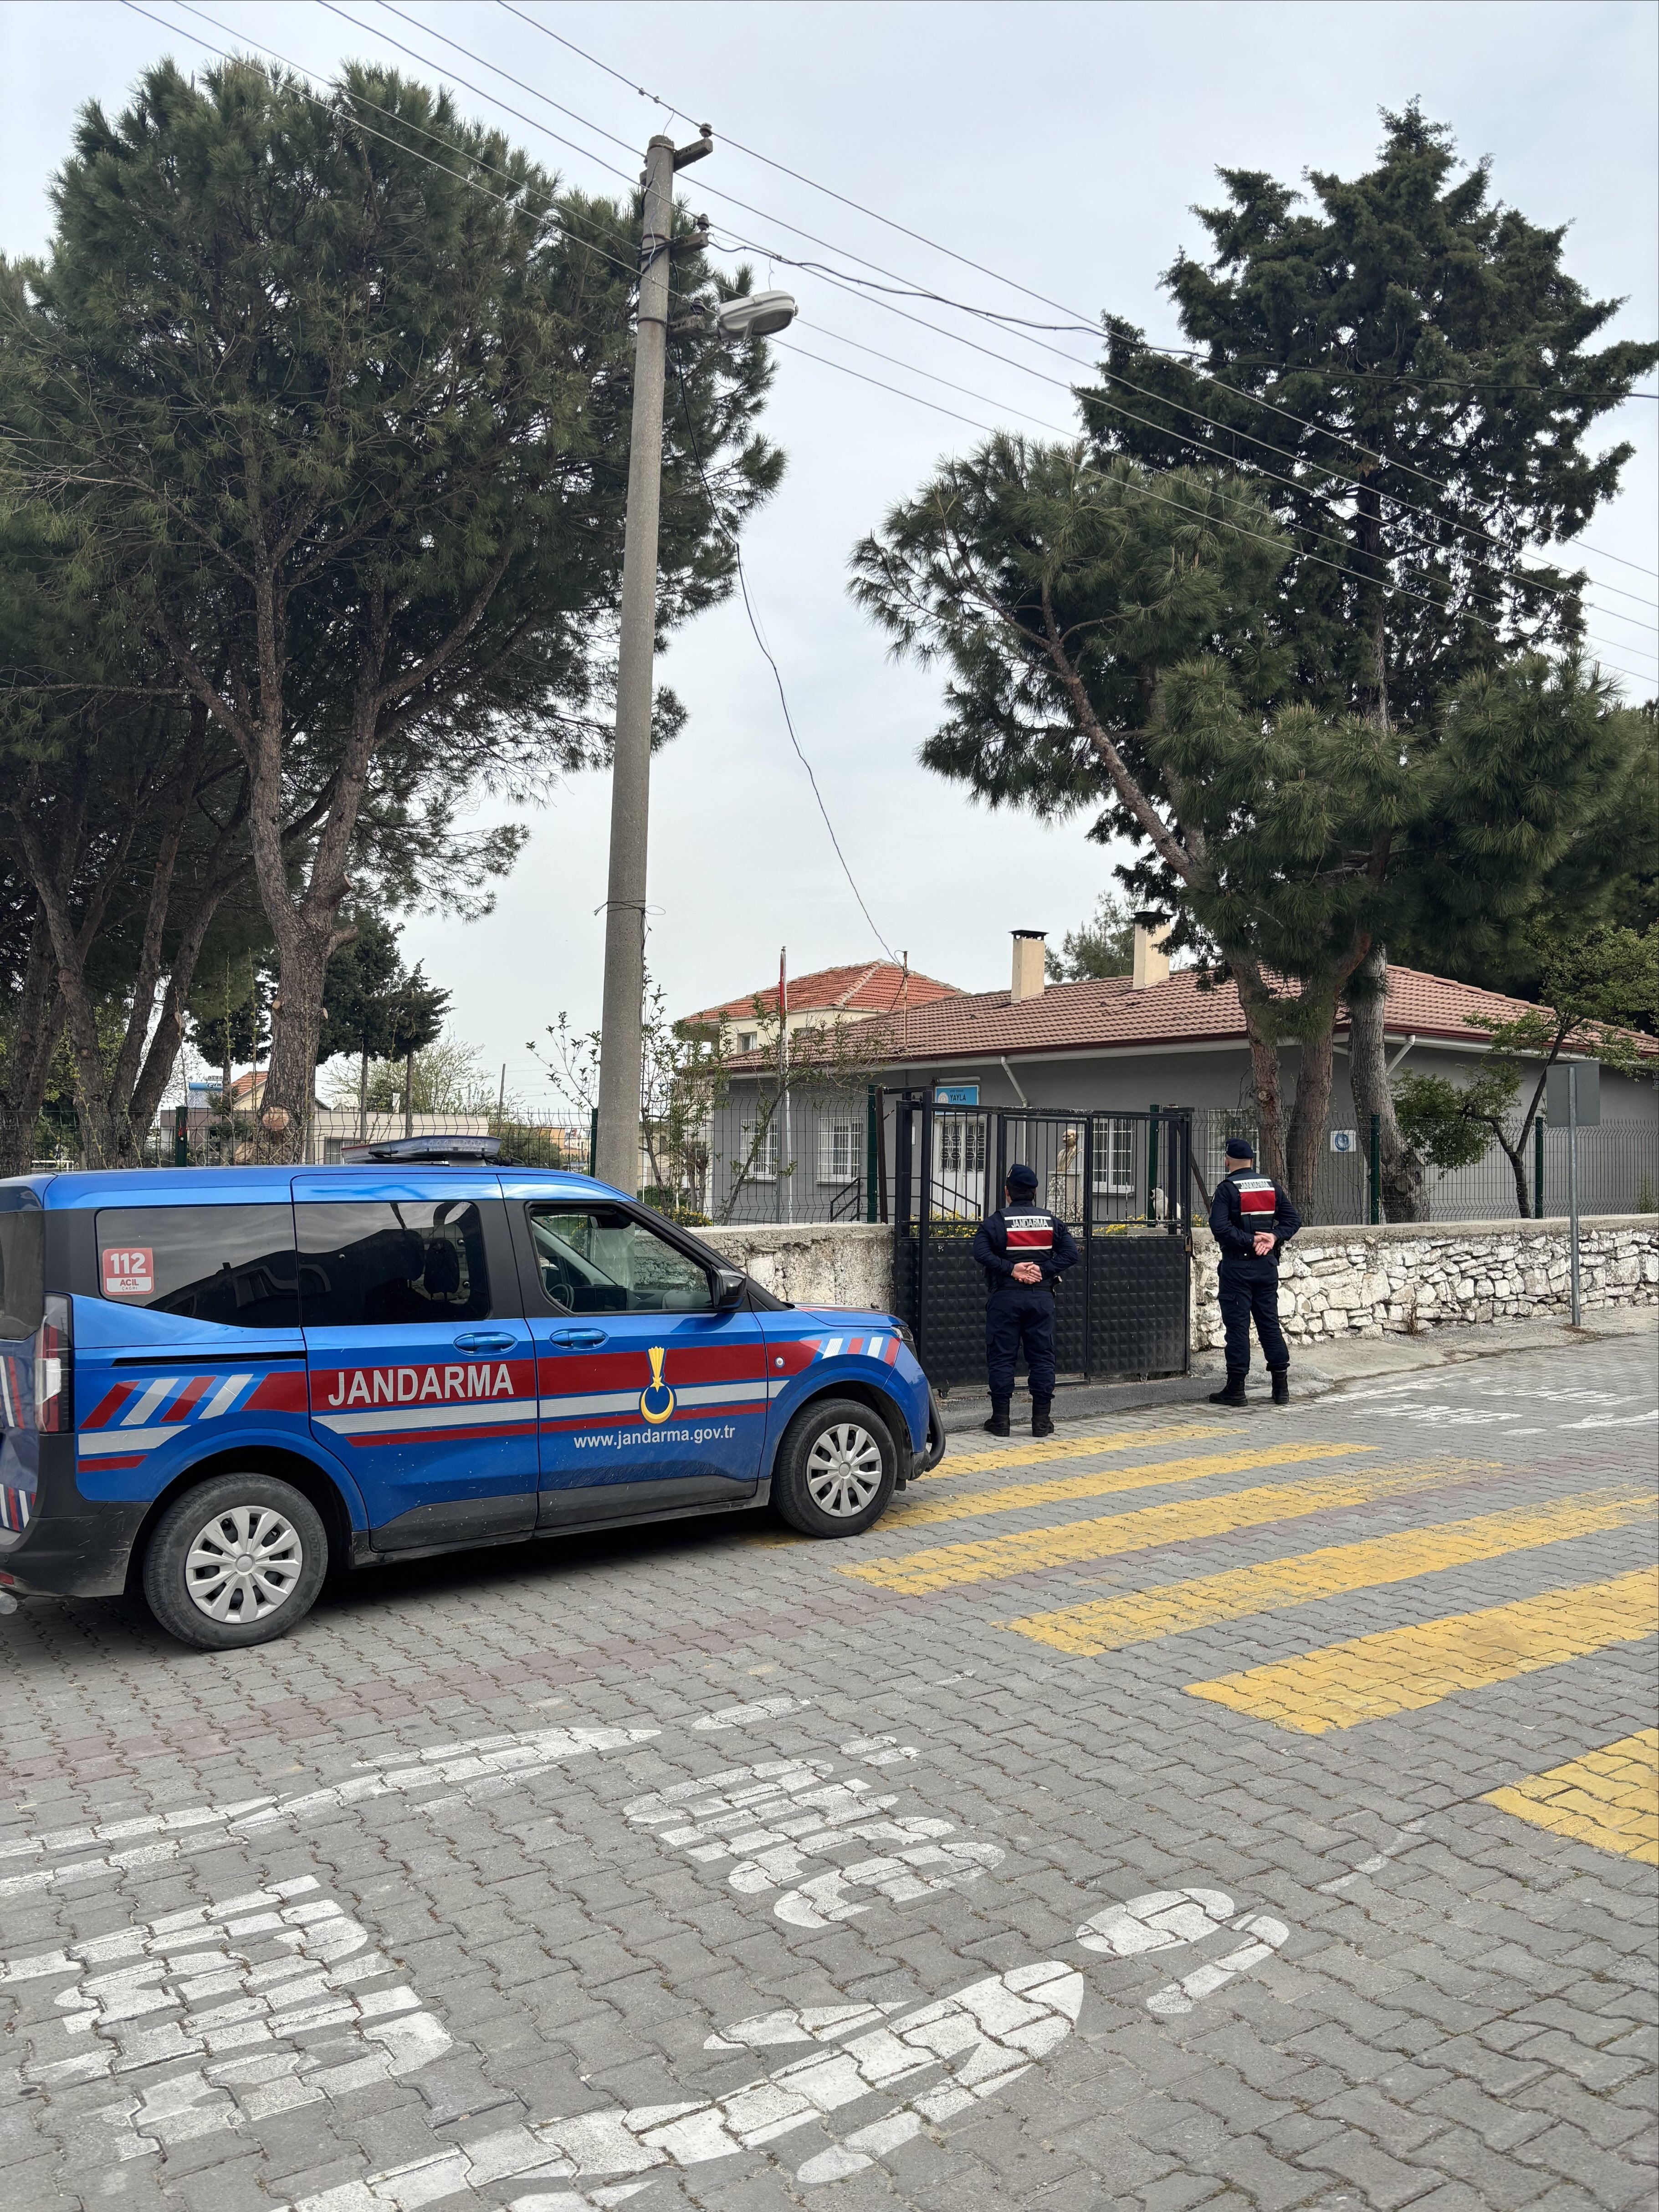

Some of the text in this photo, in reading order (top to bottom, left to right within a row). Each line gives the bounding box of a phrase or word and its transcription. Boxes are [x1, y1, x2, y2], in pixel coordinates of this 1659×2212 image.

[1011, 1219, 1049, 1228] JANDARMA
[111, 1253, 146, 1274] 112
[328, 1363, 514, 1406] JANDARMA
[573, 1424, 736, 1449] www.jandarma.gov.tr
